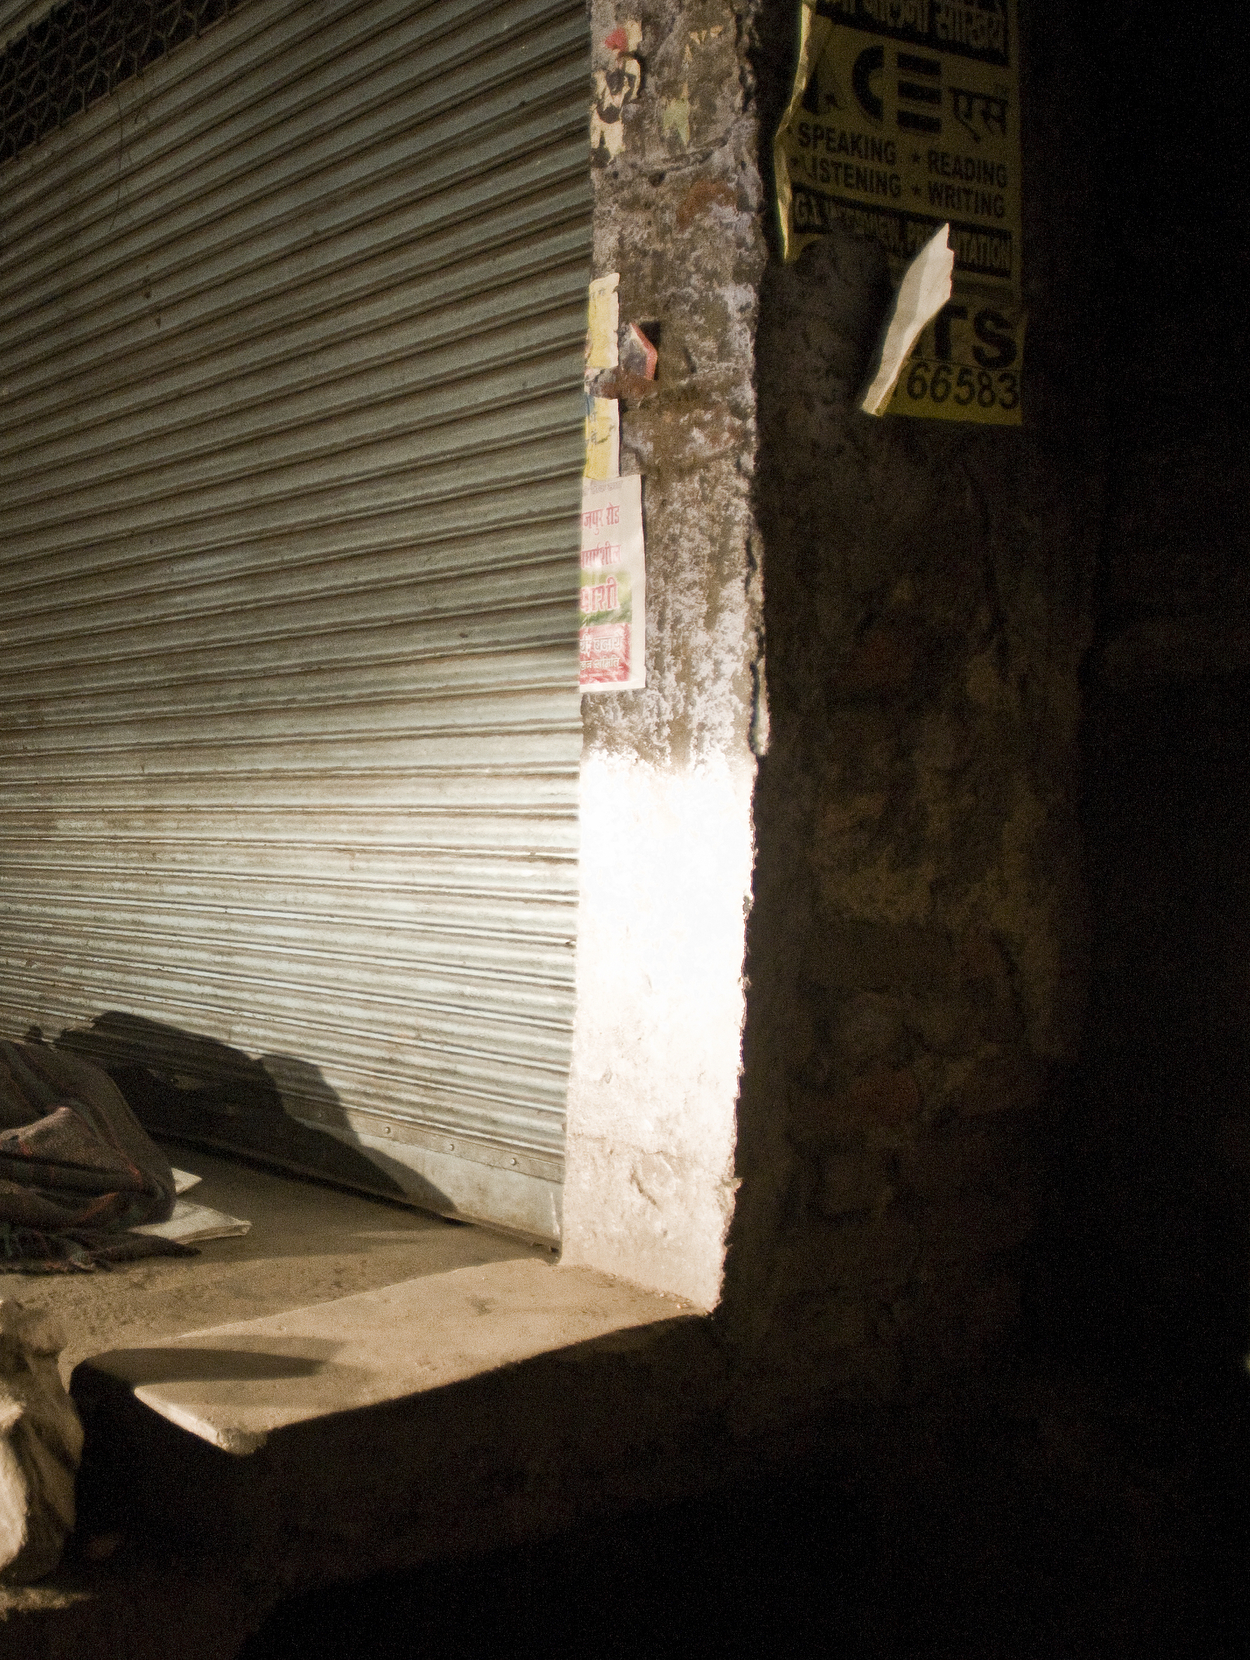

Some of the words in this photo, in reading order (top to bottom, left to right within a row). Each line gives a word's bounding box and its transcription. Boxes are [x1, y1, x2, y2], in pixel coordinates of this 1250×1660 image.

[797, 121, 897, 166] SPEAKING
[927, 149, 1007, 189] READING
[800, 153, 902, 198] LISTENING
[927, 180, 1006, 218] WRITING
[916, 304, 1018, 370] TS
[893, 361, 1019, 410] 66583
